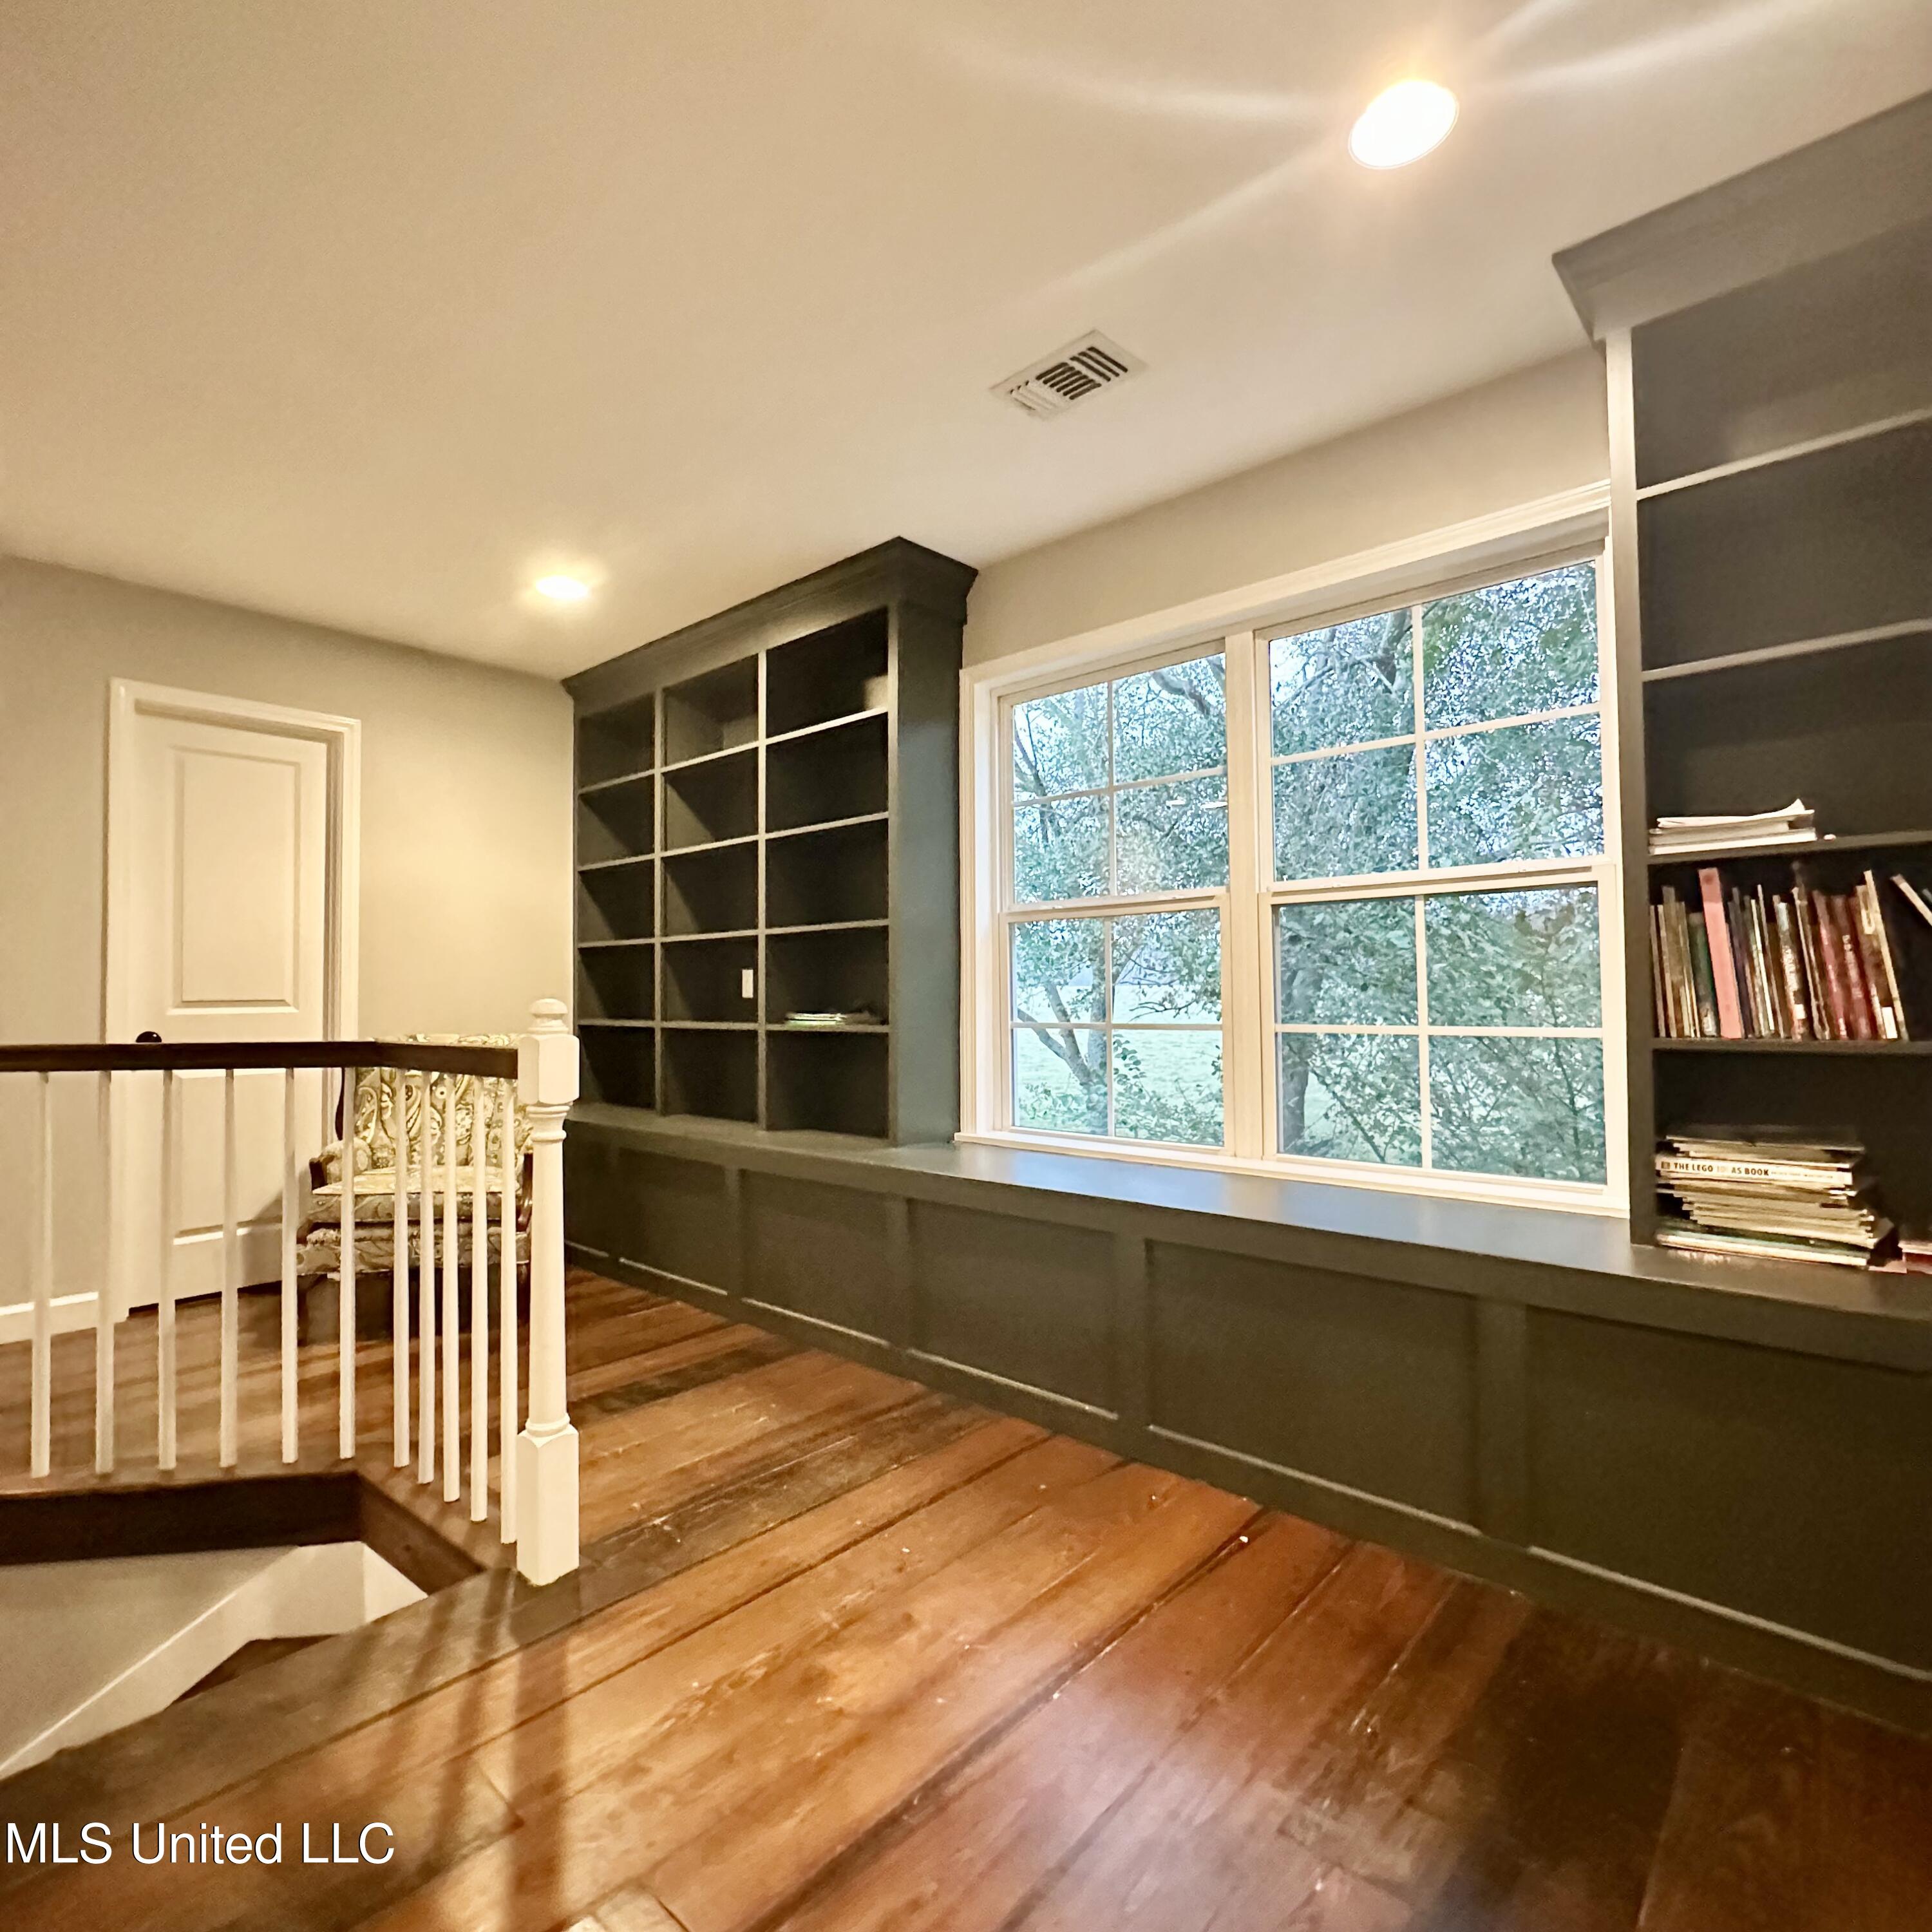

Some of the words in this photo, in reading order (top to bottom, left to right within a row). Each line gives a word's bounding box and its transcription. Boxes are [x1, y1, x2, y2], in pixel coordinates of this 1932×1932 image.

[1674, 1162, 1689, 1171] THE
[1692, 1164, 1714, 1172] LEGO
[1744, 1168, 1769, 1176] BOOK
